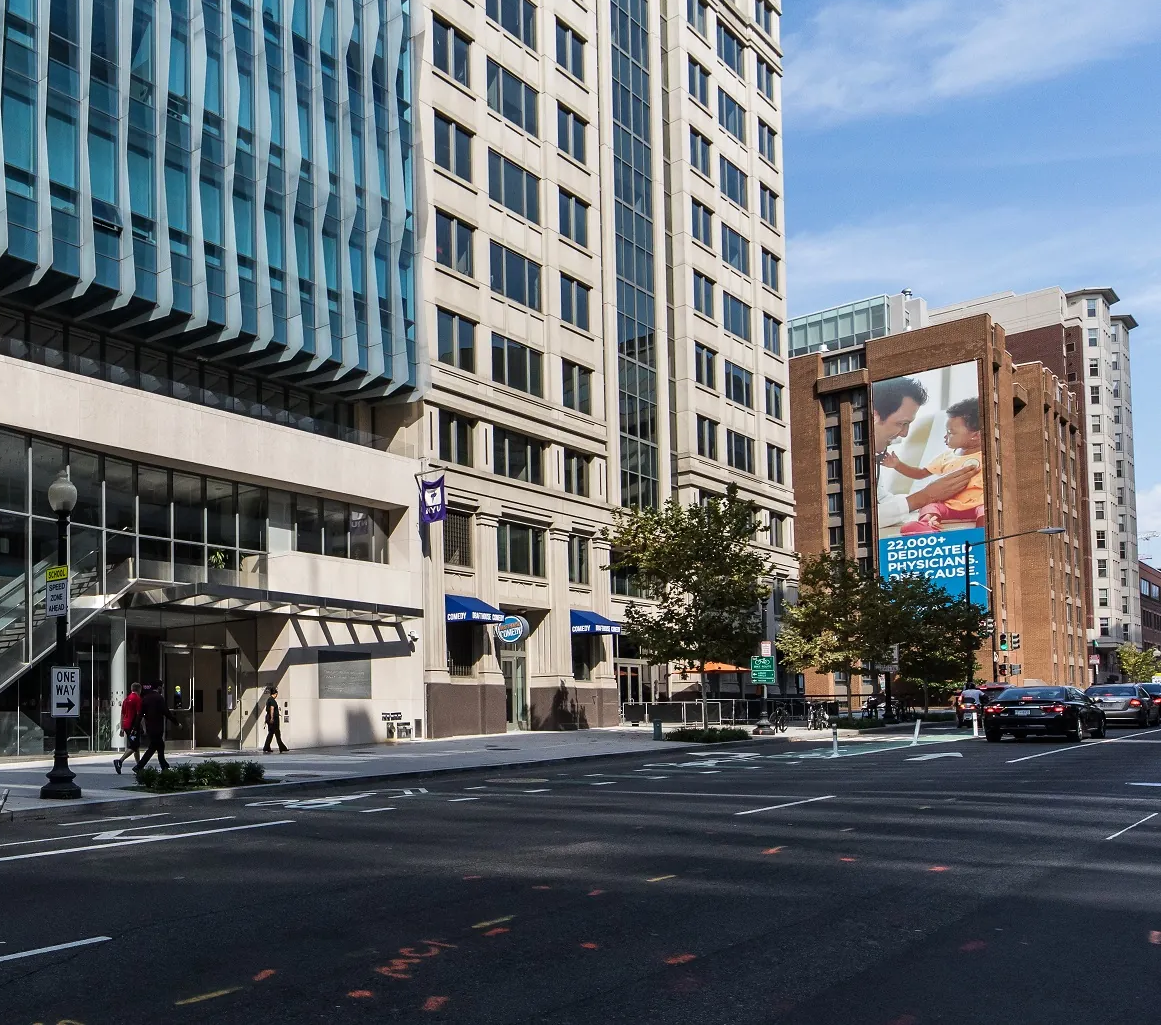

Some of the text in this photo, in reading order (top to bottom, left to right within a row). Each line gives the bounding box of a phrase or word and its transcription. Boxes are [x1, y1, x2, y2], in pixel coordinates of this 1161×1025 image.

[425, 505, 442, 515] NYU
[887, 536, 946, 550] 22,000+
[888, 554, 979, 572] PHYSICIANS.
[48, 568, 66, 579] SCHOOL
[49, 582, 66, 592] SPEED
[50, 594, 63, 602] ZONE
[49, 604, 65, 612] AHEAD
[447, 612, 467, 621] COMEDY
[500, 627, 521, 638] COMEDY
[571, 625, 591, 633] COMEDY
[56, 671, 76, 683] ONE
[55, 684, 76, 696] WAY
